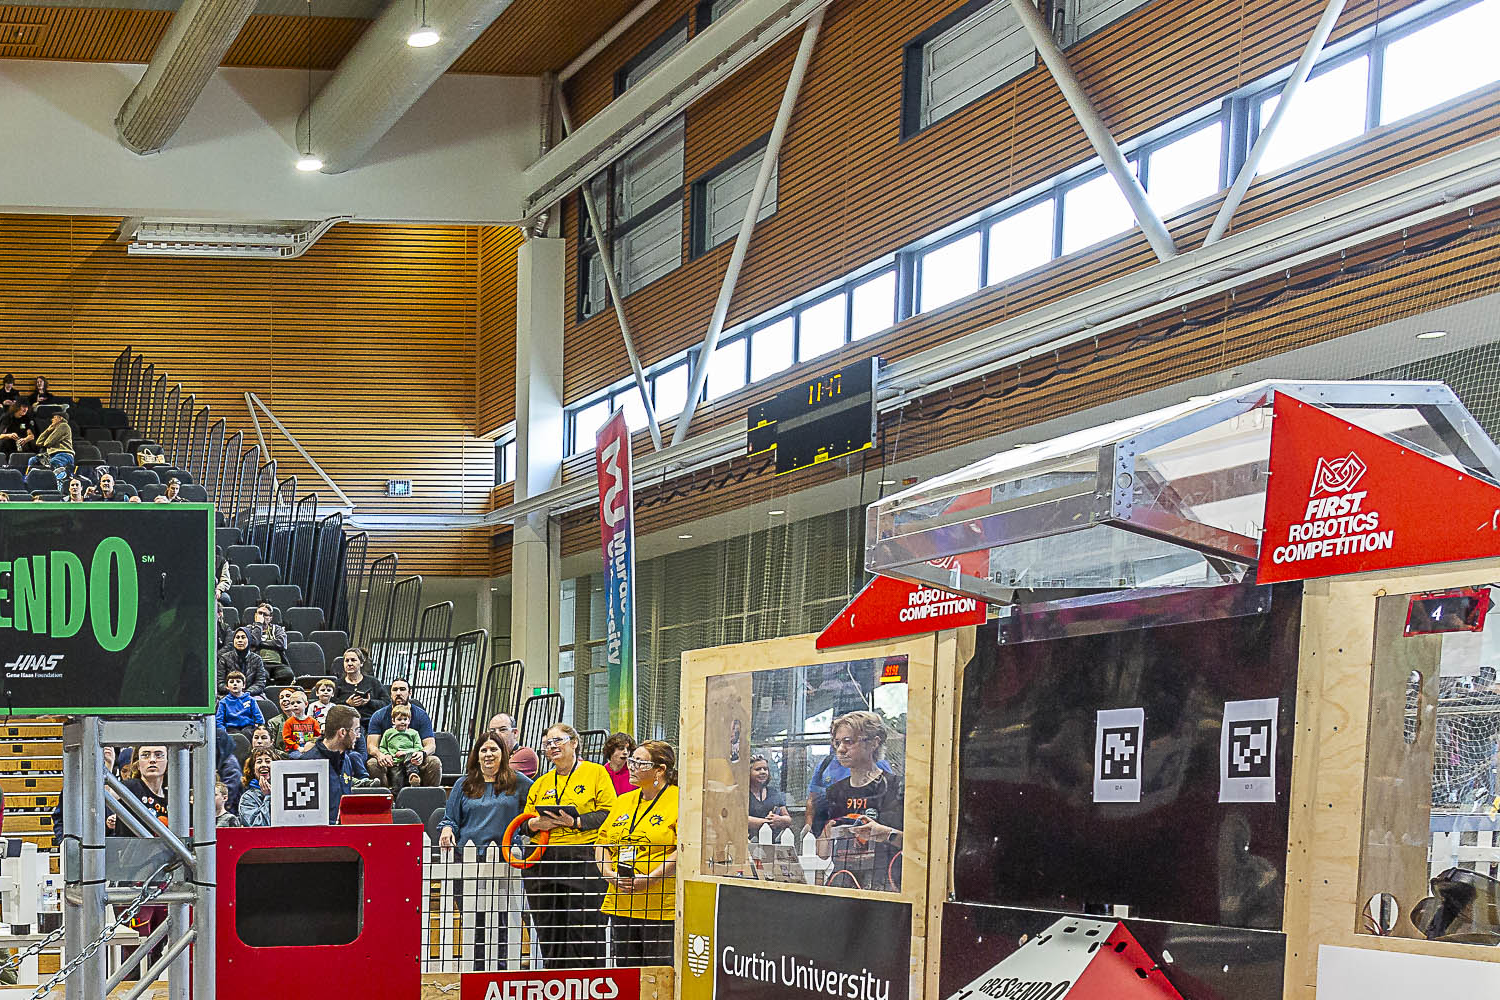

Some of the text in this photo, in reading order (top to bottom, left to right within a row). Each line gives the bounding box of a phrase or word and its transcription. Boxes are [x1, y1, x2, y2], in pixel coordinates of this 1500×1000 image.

[808, 373, 842, 405] 11:47
[601, 436, 625, 528] MU
[1304, 490, 1367, 521] FIRST
[1288, 512, 1379, 542] ROBOTICS
[141, 555, 155, 563] SM
[1273, 530, 1394, 564] COMPETITION
[899, 597, 977, 622] COMPETITION
[1431, 605, 1443, 621] 4
[4, 654, 65, 671] HAAS
[846, 798, 868, 809] 9191
[722, 946, 776, 983] Curtin
